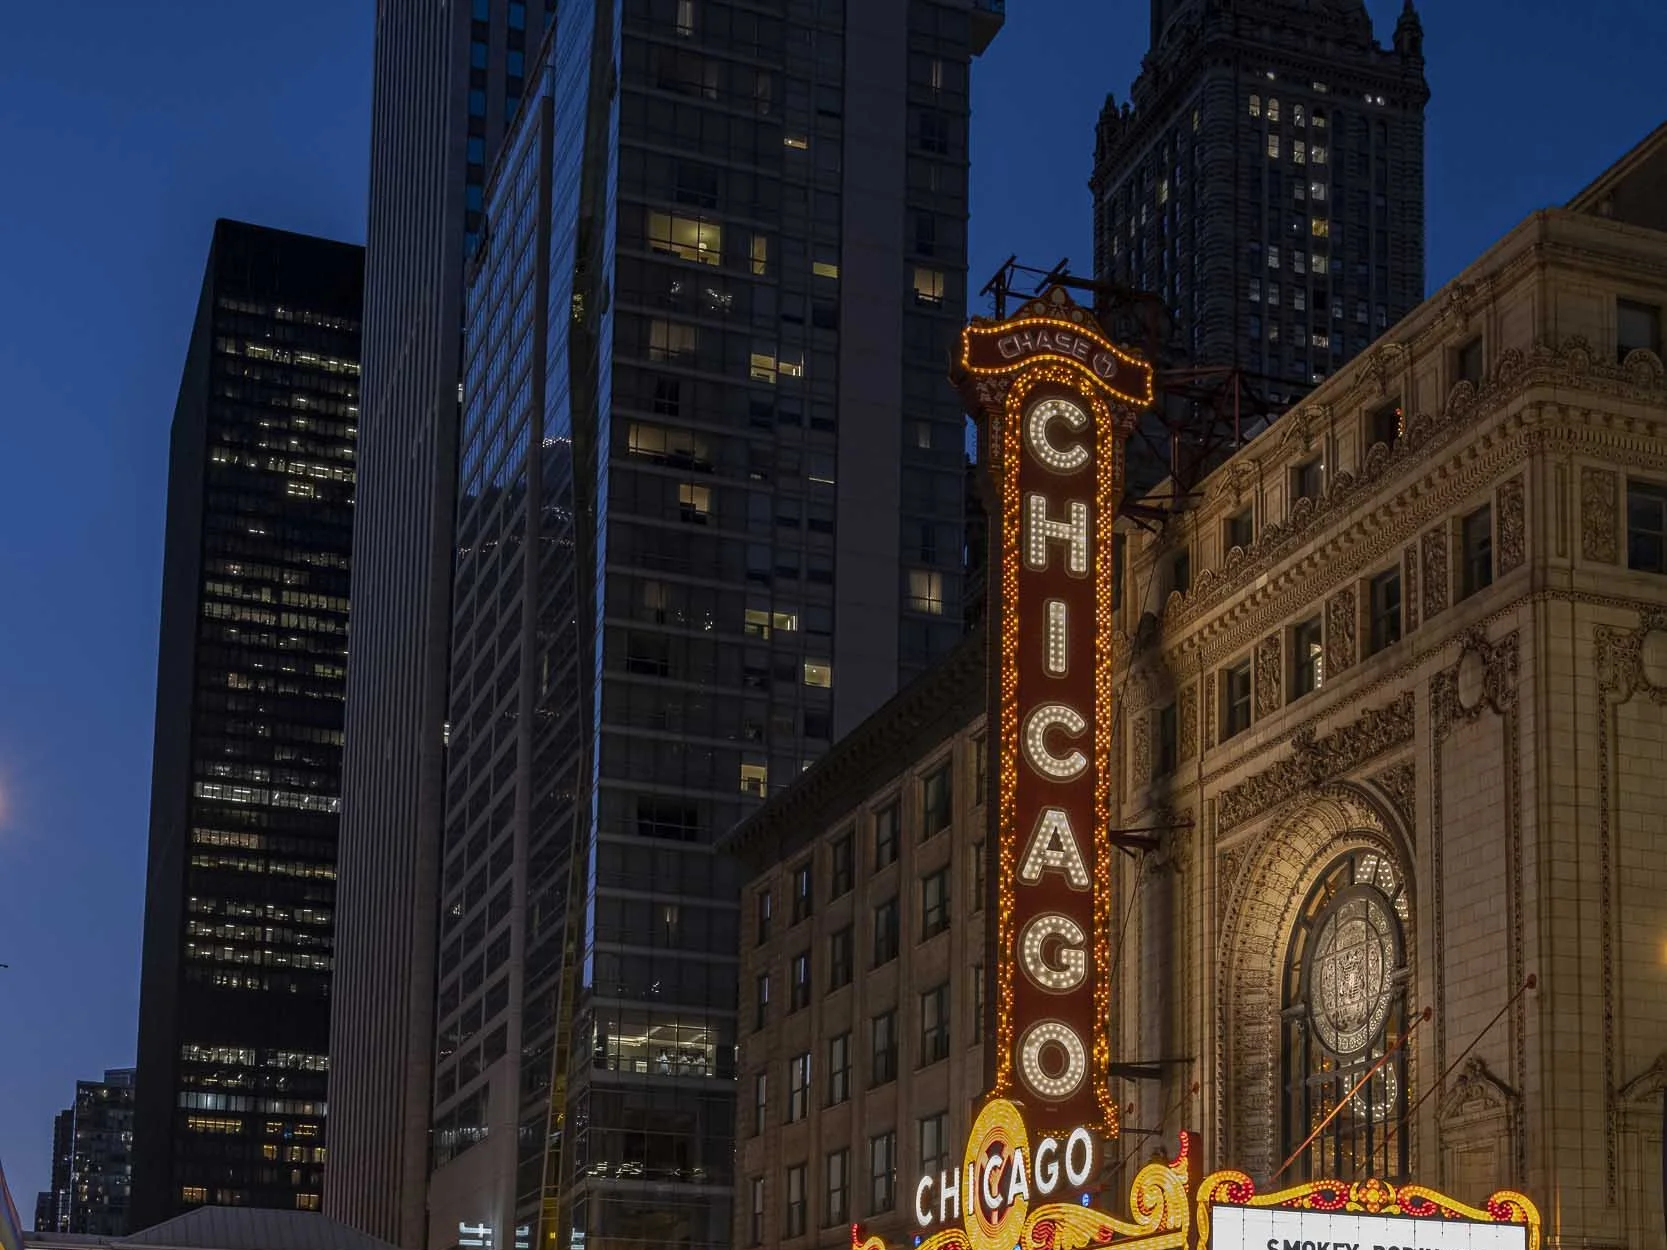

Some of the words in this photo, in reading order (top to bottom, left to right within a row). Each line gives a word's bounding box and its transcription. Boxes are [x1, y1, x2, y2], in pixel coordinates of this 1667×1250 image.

[997, 330, 1090, 361] CHASE
[1020, 398, 1090, 1097] CHICAGO
[915, 1127, 1093, 1226] CHICAGO
